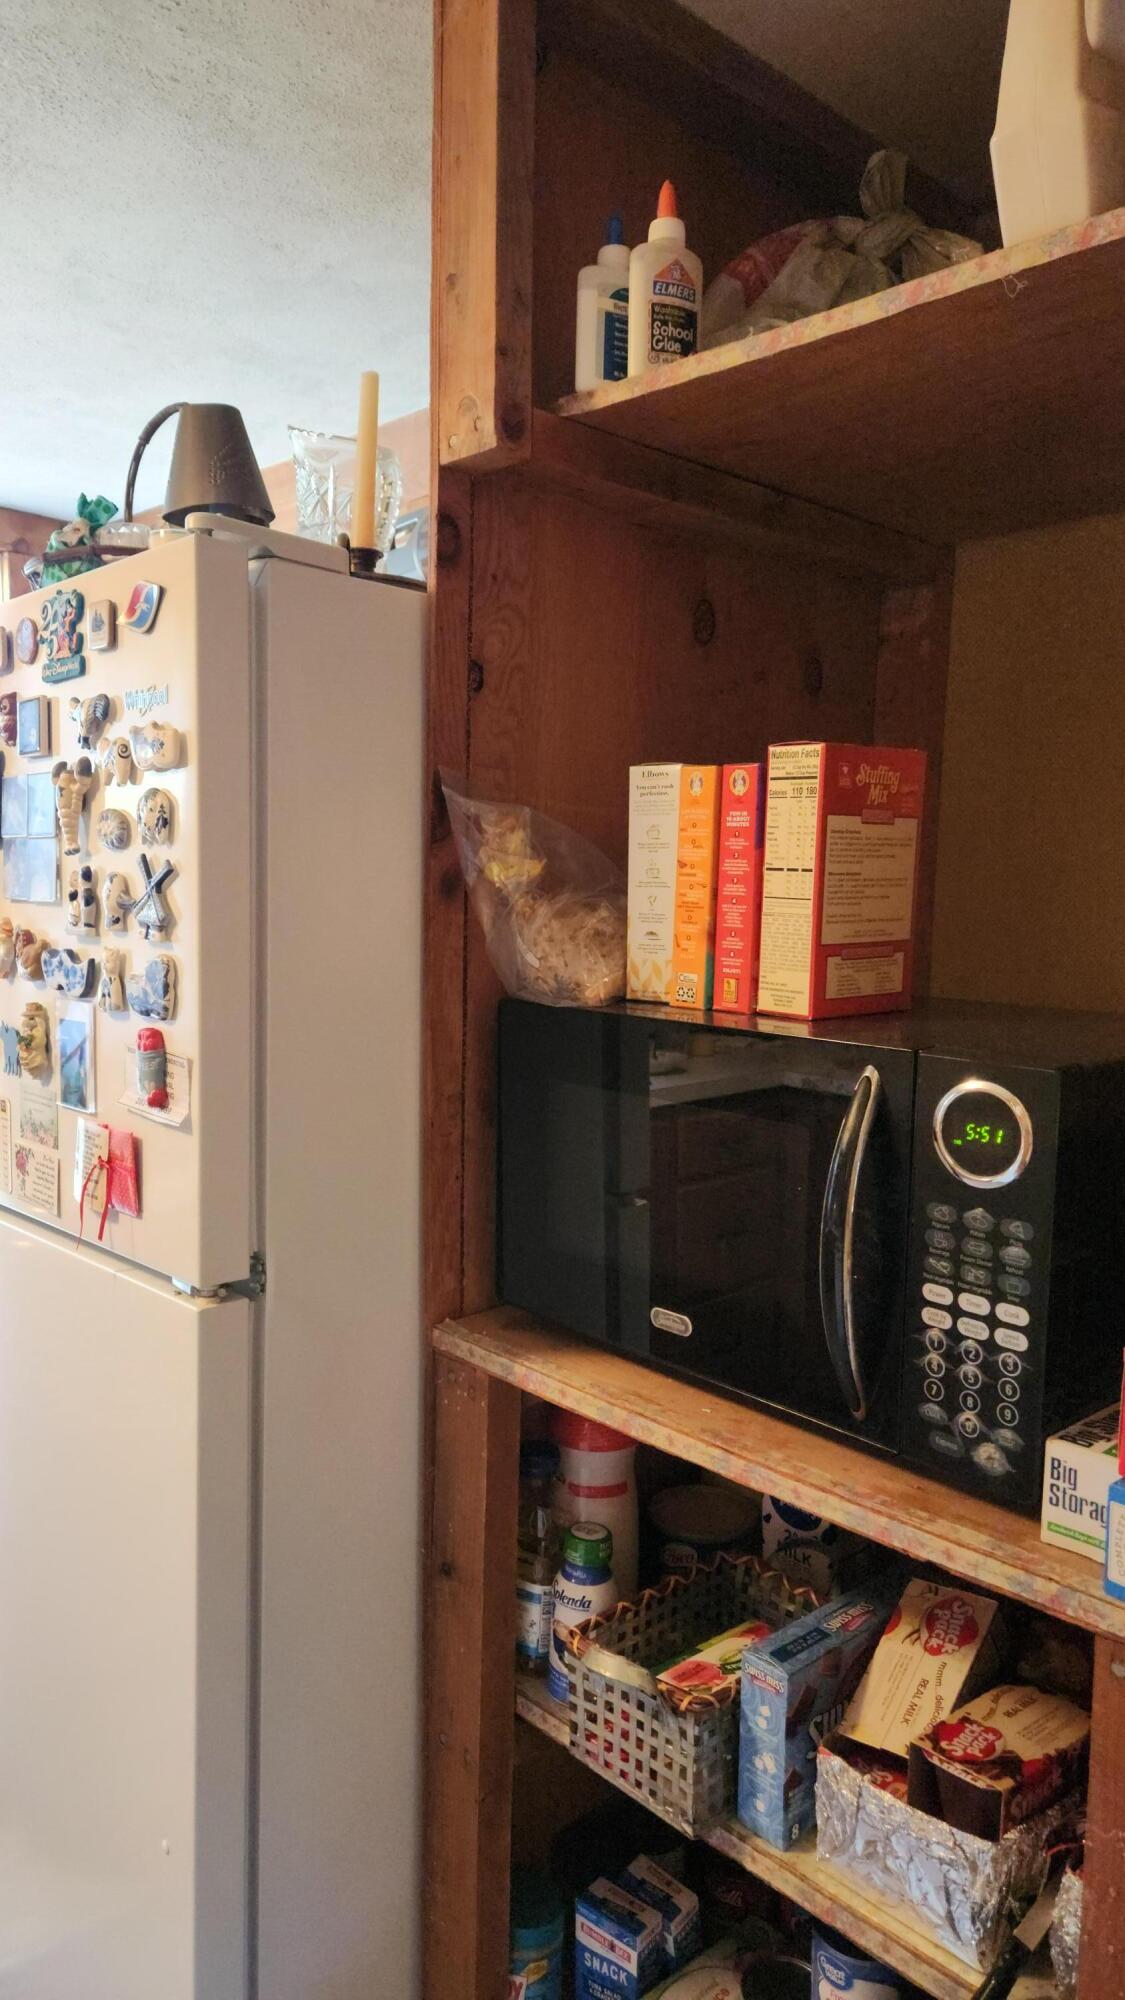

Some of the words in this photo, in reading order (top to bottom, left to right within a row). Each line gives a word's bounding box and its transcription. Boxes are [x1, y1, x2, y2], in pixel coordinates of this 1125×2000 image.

[653, 322, 693, 342] School
[653, 336, 681, 352] Glue
[771, 749, 800, 760] Nutrition
[801, 747, 820, 759] Facts
[856, 763, 900, 794] Stuffing
[792, 787, 803, 796] 110
[867, 784, 889, 805] Mix
[966, 1123, 1004, 1144] 5:51
[933, 1336, 939, 1348] 1
[968, 1348, 976, 1360] 2
[966, 1371, 974, 1383] 5
[930, 1384, 938, 1395] 7
[1005, 1383, 1013, 1396] 6
[966, 1396, 974, 1408] 8
[1004, 1408, 1012, 1420] 9
[1050, 1456, 1078, 1491] Big
[552, 1579, 593, 1609] Splenda
[823, 1610, 852, 1632] SWISS
[926, 1608, 951, 1648] Pack
[940, 1600, 974, 1656] Snack
[744, 1662, 764, 1681] SWISS
[765, 1675, 784, 1693] MISS
[912, 1678, 930, 1700] REAL
[900, 1701, 918, 1728] MILK
[940, 1722, 984, 1756] Snack
[791, 1823, 799, 1840] 8
[584, 1952, 629, 1986] SNACK
